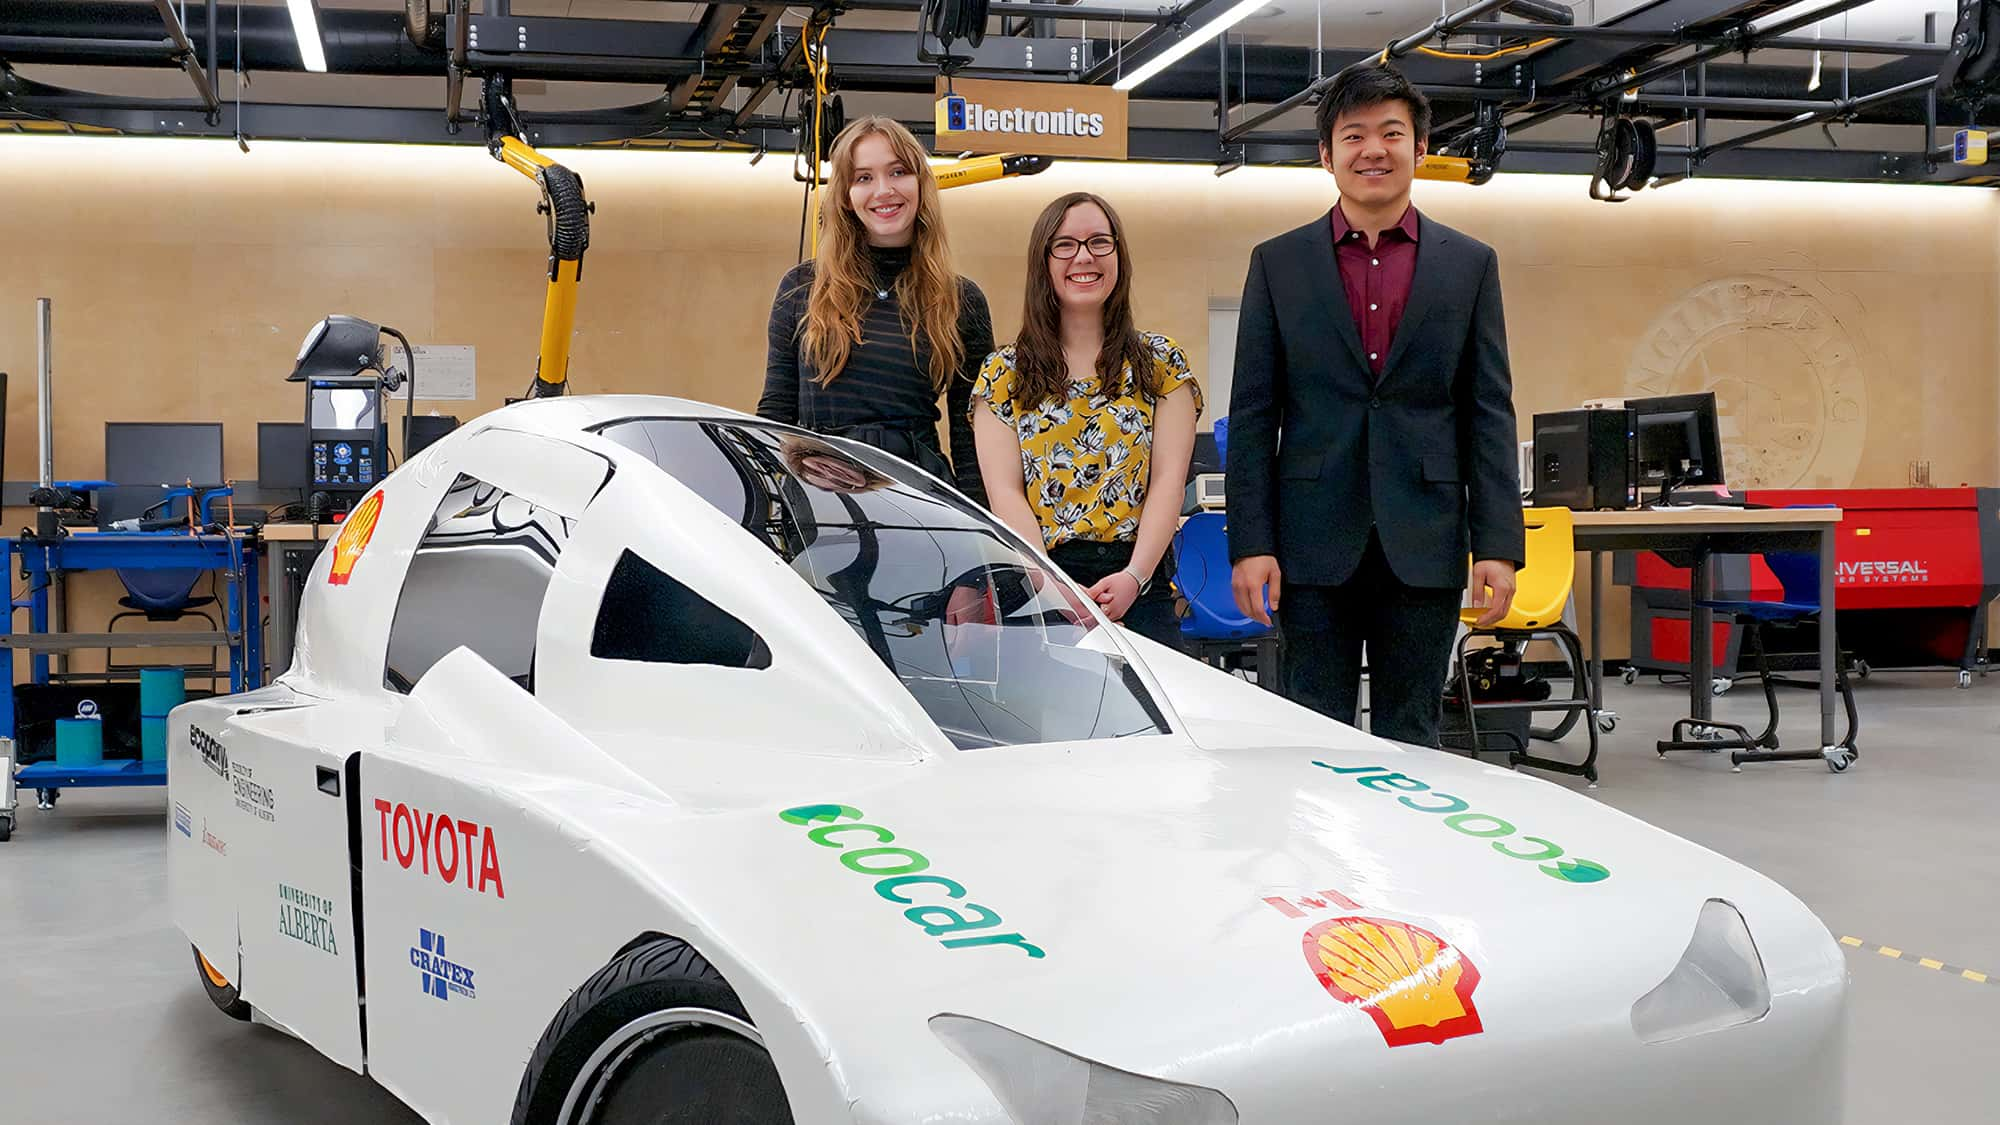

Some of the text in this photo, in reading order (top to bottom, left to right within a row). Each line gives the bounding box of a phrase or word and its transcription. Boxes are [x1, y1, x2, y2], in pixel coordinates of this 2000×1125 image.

[966, 103, 1105, 138] Electronics
[1835, 560, 1928, 576] IVERSAL
[1312, 760, 1611, 883] ecocar
[375, 798, 504, 899] TOYOTA
[279, 883, 333, 917] UNIVERSITY OF
[779, 804, 1046, 959] ecocar
[279, 903, 338, 956] ALBERTA
[410, 947, 476, 990] CRATEX
